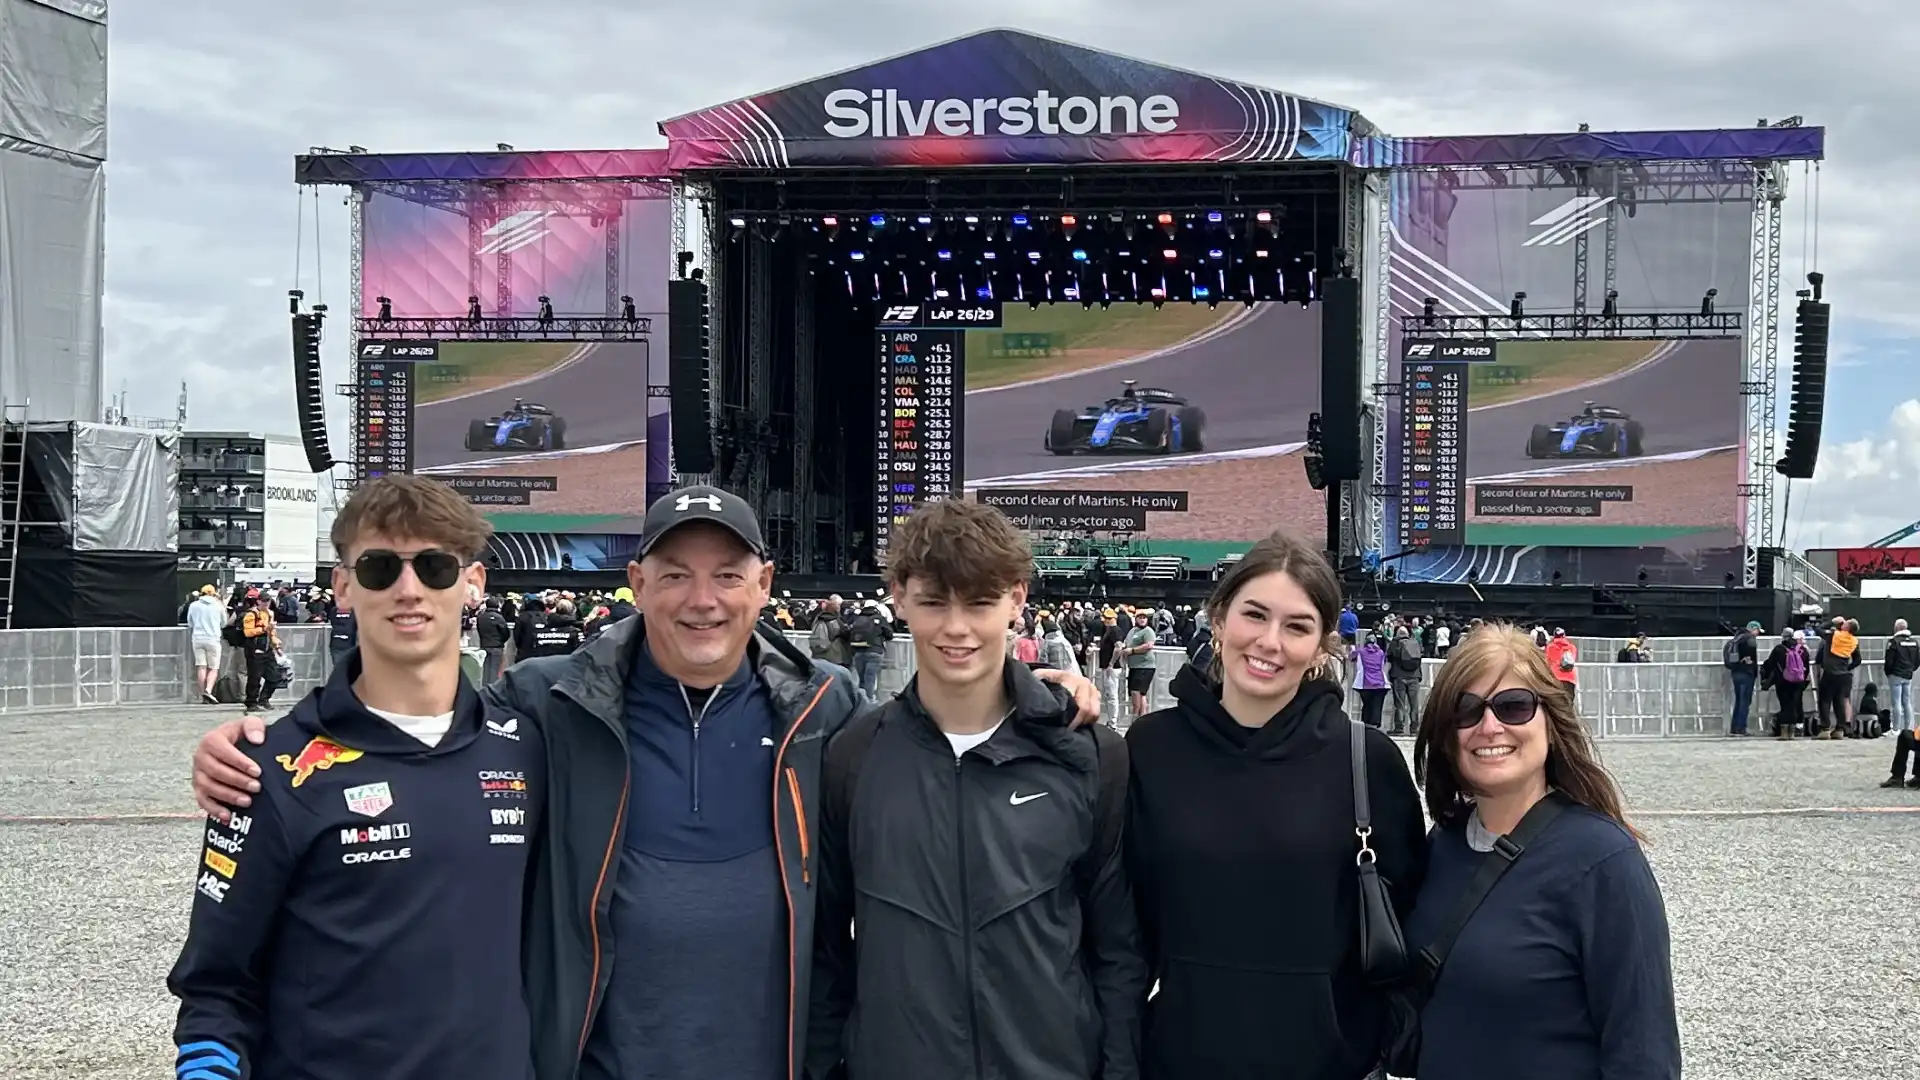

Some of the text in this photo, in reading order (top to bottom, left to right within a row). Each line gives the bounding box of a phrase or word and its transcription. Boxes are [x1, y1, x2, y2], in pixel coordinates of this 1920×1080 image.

[823, 87, 1179, 138] Silverstone
[883, 306, 919, 319] F2
[931, 308, 995, 321] LAP 26/29
[895, 333, 917, 342] ARO
[362, 345, 386, 355] F2
[931, 344, 951, 353] +6.1
[1407, 344, 1434, 356] F2
[1443, 347, 1491, 357] LAP 26/29
[895, 355, 916, 363] CRA
[925, 354, 951, 363] +11.2
[925, 365, 951, 374] +13.3
[895, 376, 918, 385] MAL
[925, 376, 952, 385] +14.6
[895, 387, 914, 396] COL
[925, 387, 951, 396] +19.5
[881, 398, 951, 407] 7 VMA +21.4
[895, 408, 916, 417] BOR
[925, 409, 950, 417] +25.1
[894, 419, 915, 428] BEA
[925, 419, 951, 428] +26.5
[924, 430, 951, 439] +28.7
[878, 441, 951, 450] 11 HAU +29.8
[924, 452, 951, 461] +31.0
[894, 462, 916, 471] OSU
[924, 462, 951, 471] +34.5
[924, 473, 950, 482] +35.3
[878, 484, 950, 493] 15 VER +38.1
[267, 486, 317, 502] BROOKLANDS
[1590, 490, 1604, 498] He
[894, 495, 914, 503] MIY
[985, 494, 1179, 509] second clear of Martins. He only
[1536, 506, 1543, 514] a
[878, 516, 888, 524] 18
[1060, 516, 1067, 526] a
[1110, 517, 1136, 530] ago.
[478, 771, 525, 781] ORACLE
[340, 825, 392, 845] Mobil
[341, 848, 411, 864] ORACLE
